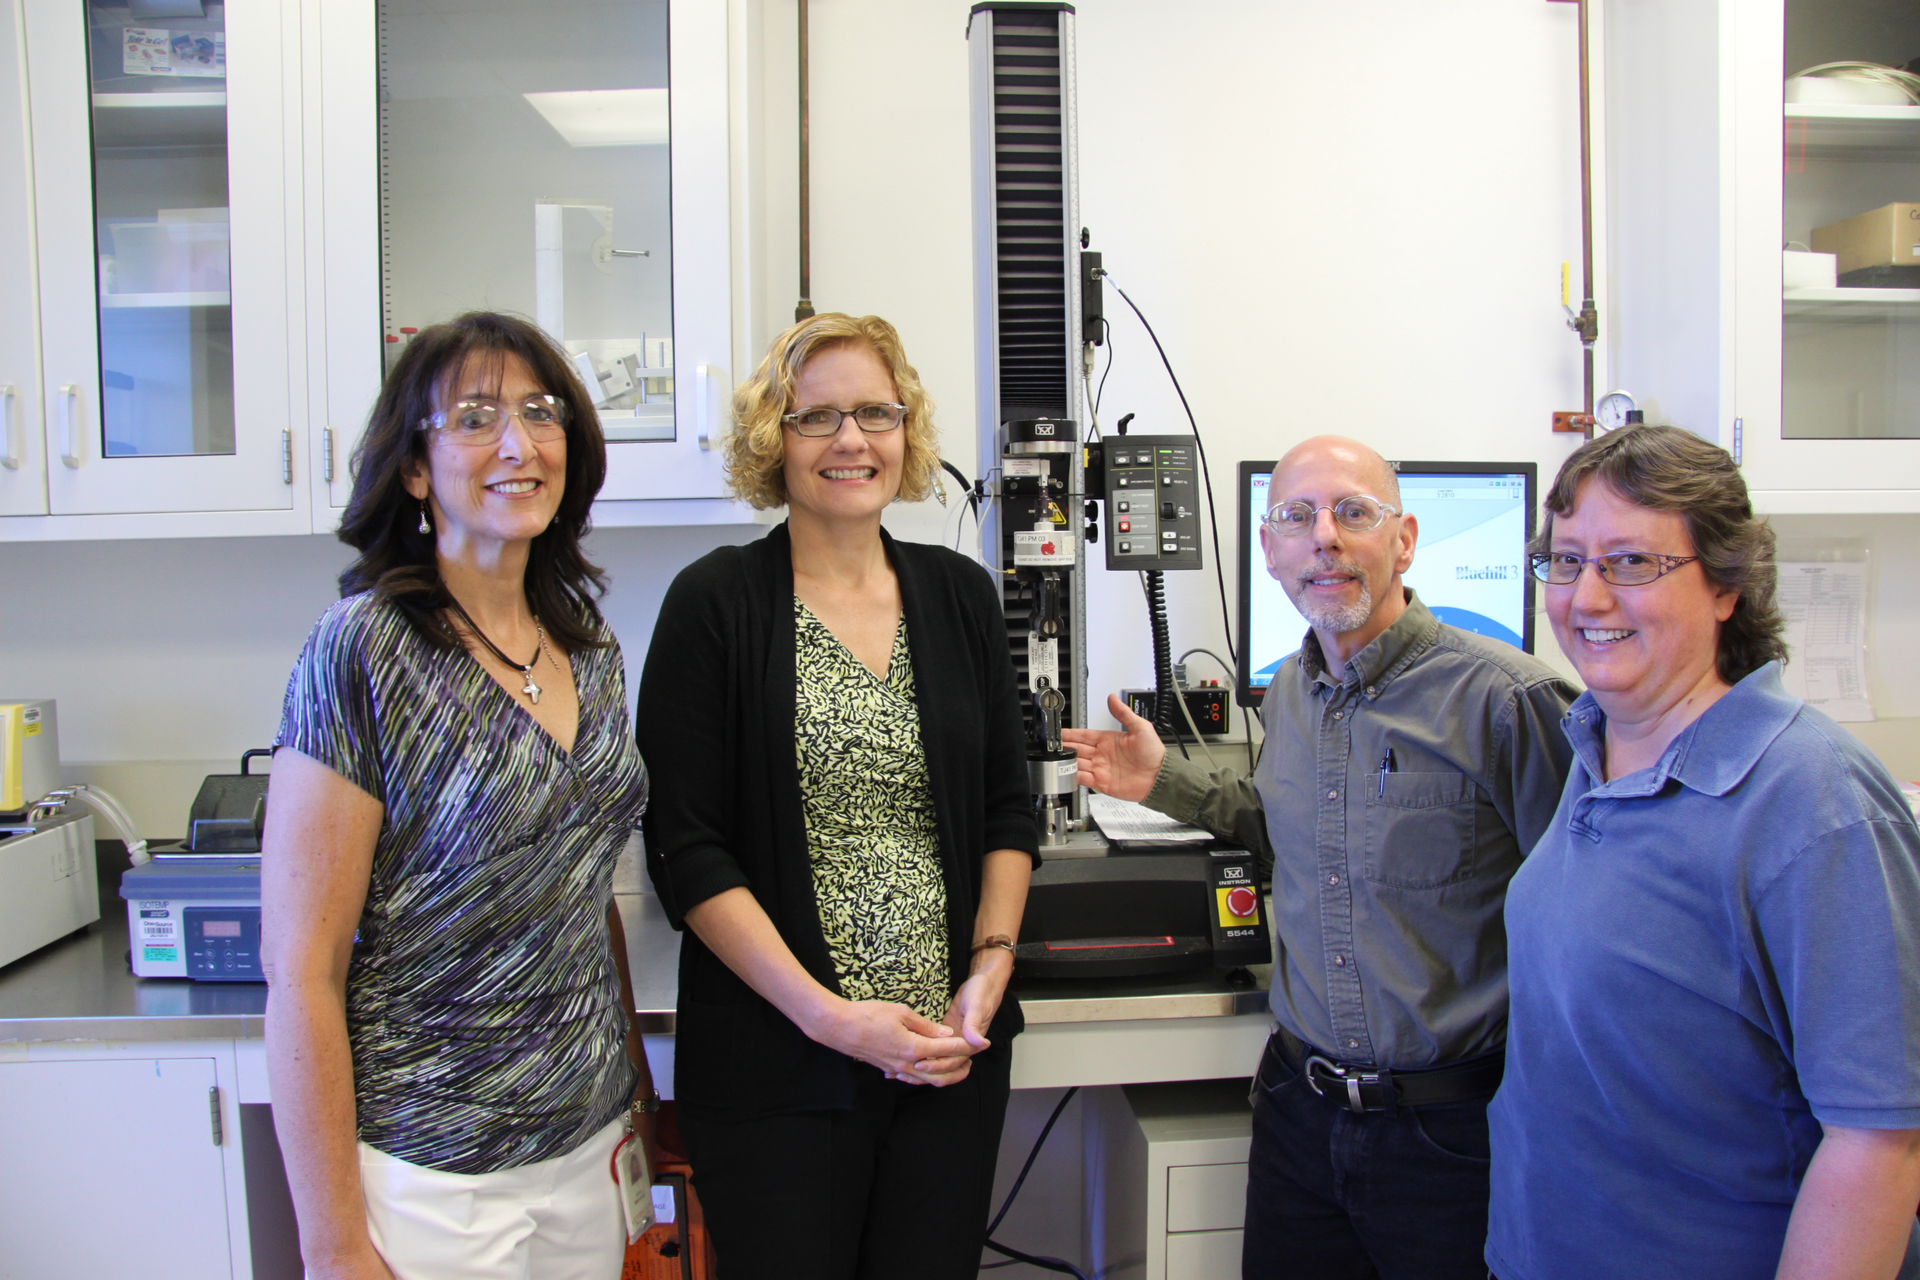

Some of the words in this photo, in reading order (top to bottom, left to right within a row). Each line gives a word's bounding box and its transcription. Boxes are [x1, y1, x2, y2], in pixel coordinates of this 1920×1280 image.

[1455, 565, 1508, 580] Bluehill
[1510, 564, 1519, 580] 3
[139, 901, 169, 909] ISOTEMP
[1226, 929, 1255, 937] 5544
